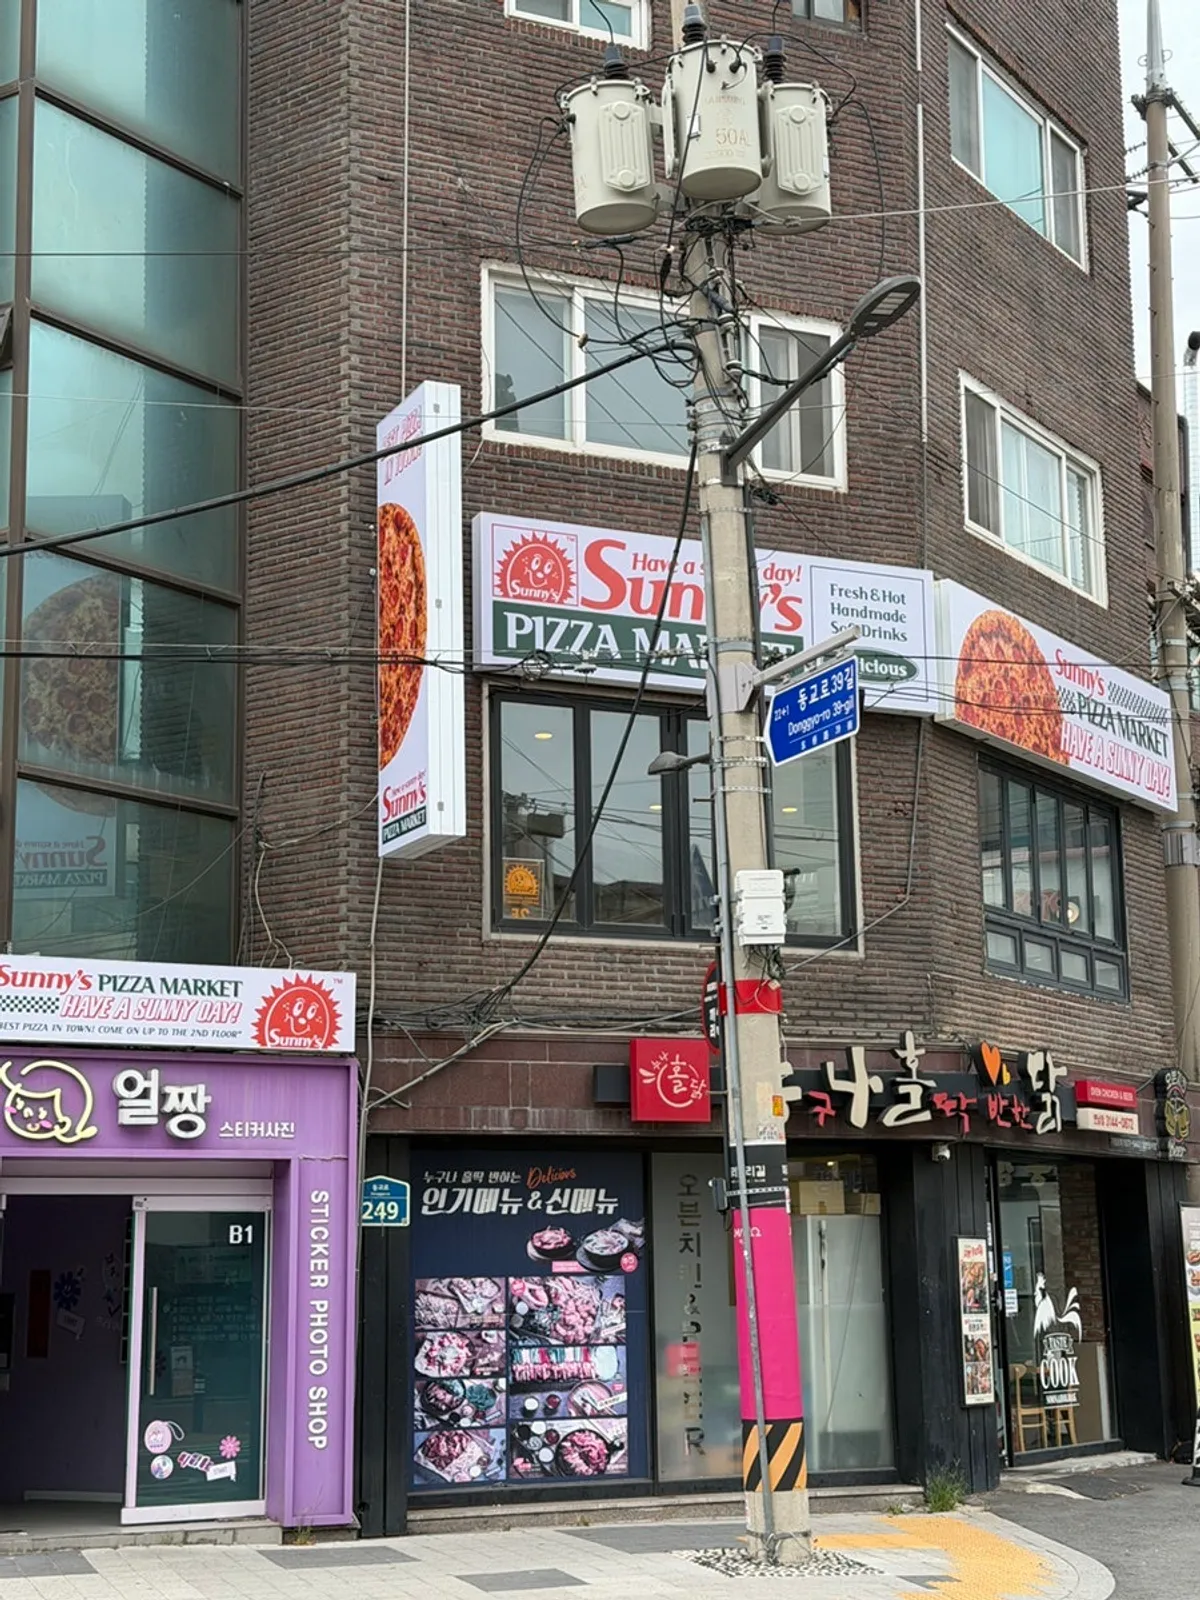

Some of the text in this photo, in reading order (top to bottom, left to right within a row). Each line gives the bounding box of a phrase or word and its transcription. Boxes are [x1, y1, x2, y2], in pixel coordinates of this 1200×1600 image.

[683, 561, 695, 574] a
[763, 562, 801, 586] day!
[511, 579, 560, 603] Sunny's
[581, 539, 803, 632] Sun's
[830, 583, 906, 605] Fresh & Hot
[830, 602, 907, 624] Handmade
[503, 611, 622, 660] PIZZA
[861, 623, 908, 643] Drinks
[860, 657, 908, 677] icious
[1055, 648, 1105, 698] Sunny's
[797, 663, 855, 712] 동교로39길
[787, 708, 832, 737] Donggyo-ro
[1076, 690, 1169, 759] PIZZA MARKET
[1060, 720, 1172, 798] HAVE A SUNNY DAY!
[382, 782, 427, 823] Sunny's
[0, 964, 244, 998] Sunny's PIZZA MARKET
[60, 994, 243, 1024] HAVE A SUNNY DAY!
[22, 1022, 49, 1032] PIZZA
[66, 1024, 96, 1034] TOWN!
[98, 1025, 124, 1035] COME
[269, 1028, 324, 1049] Sunny's
[112, 1068, 213, 1140] 얼짱
[219, 1121, 296, 1139] 스티커사진
[422, 1170, 458, 1184] 누구나
[362, 1201, 399, 1220] 249
[421, 1187, 618, 1215] 인기메뉴 & 신메뉴
[229, 1224, 254, 1245] B1
[308, 1189, 330, 1450] STICKER PHOTO SHOP
[1040, 1356, 1080, 1390] COOK
